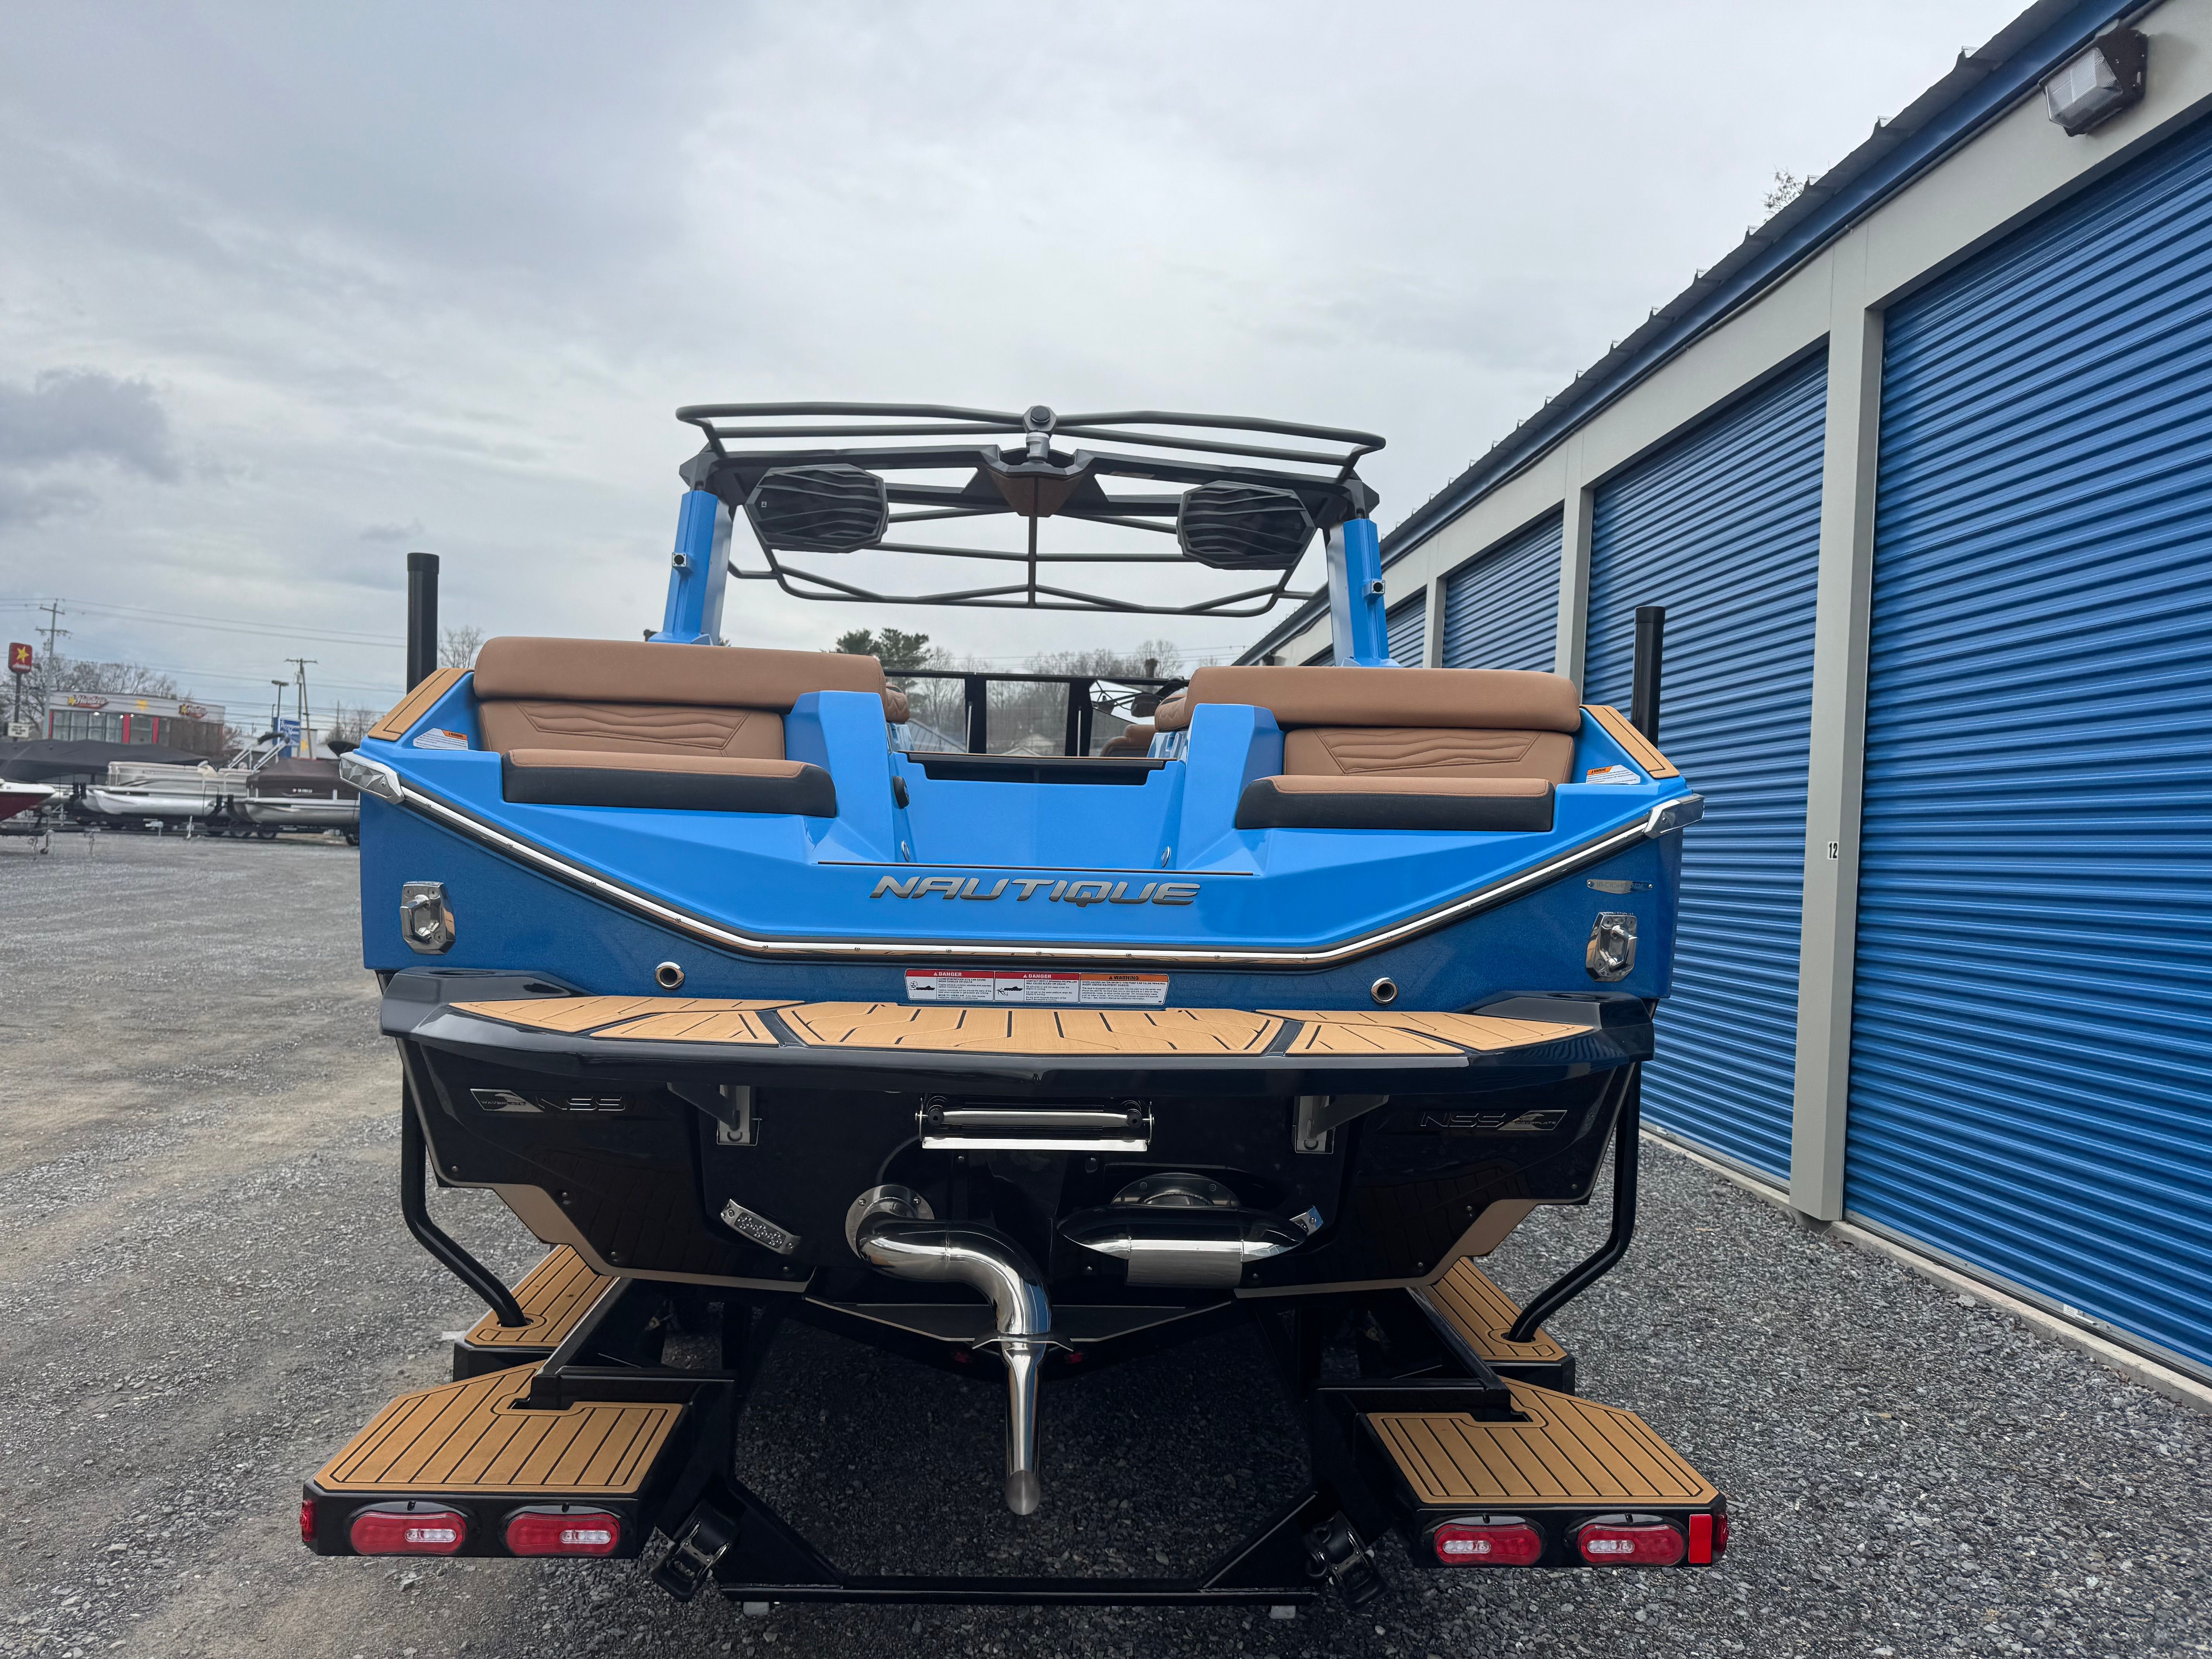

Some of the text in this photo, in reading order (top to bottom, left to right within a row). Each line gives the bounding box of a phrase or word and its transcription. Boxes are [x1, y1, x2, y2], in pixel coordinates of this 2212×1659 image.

[1829, 842, 1838, 859] 12
[870, 876, 1200, 907] NAUTIQUE
[1420, 1112, 1506, 1127] NSS
